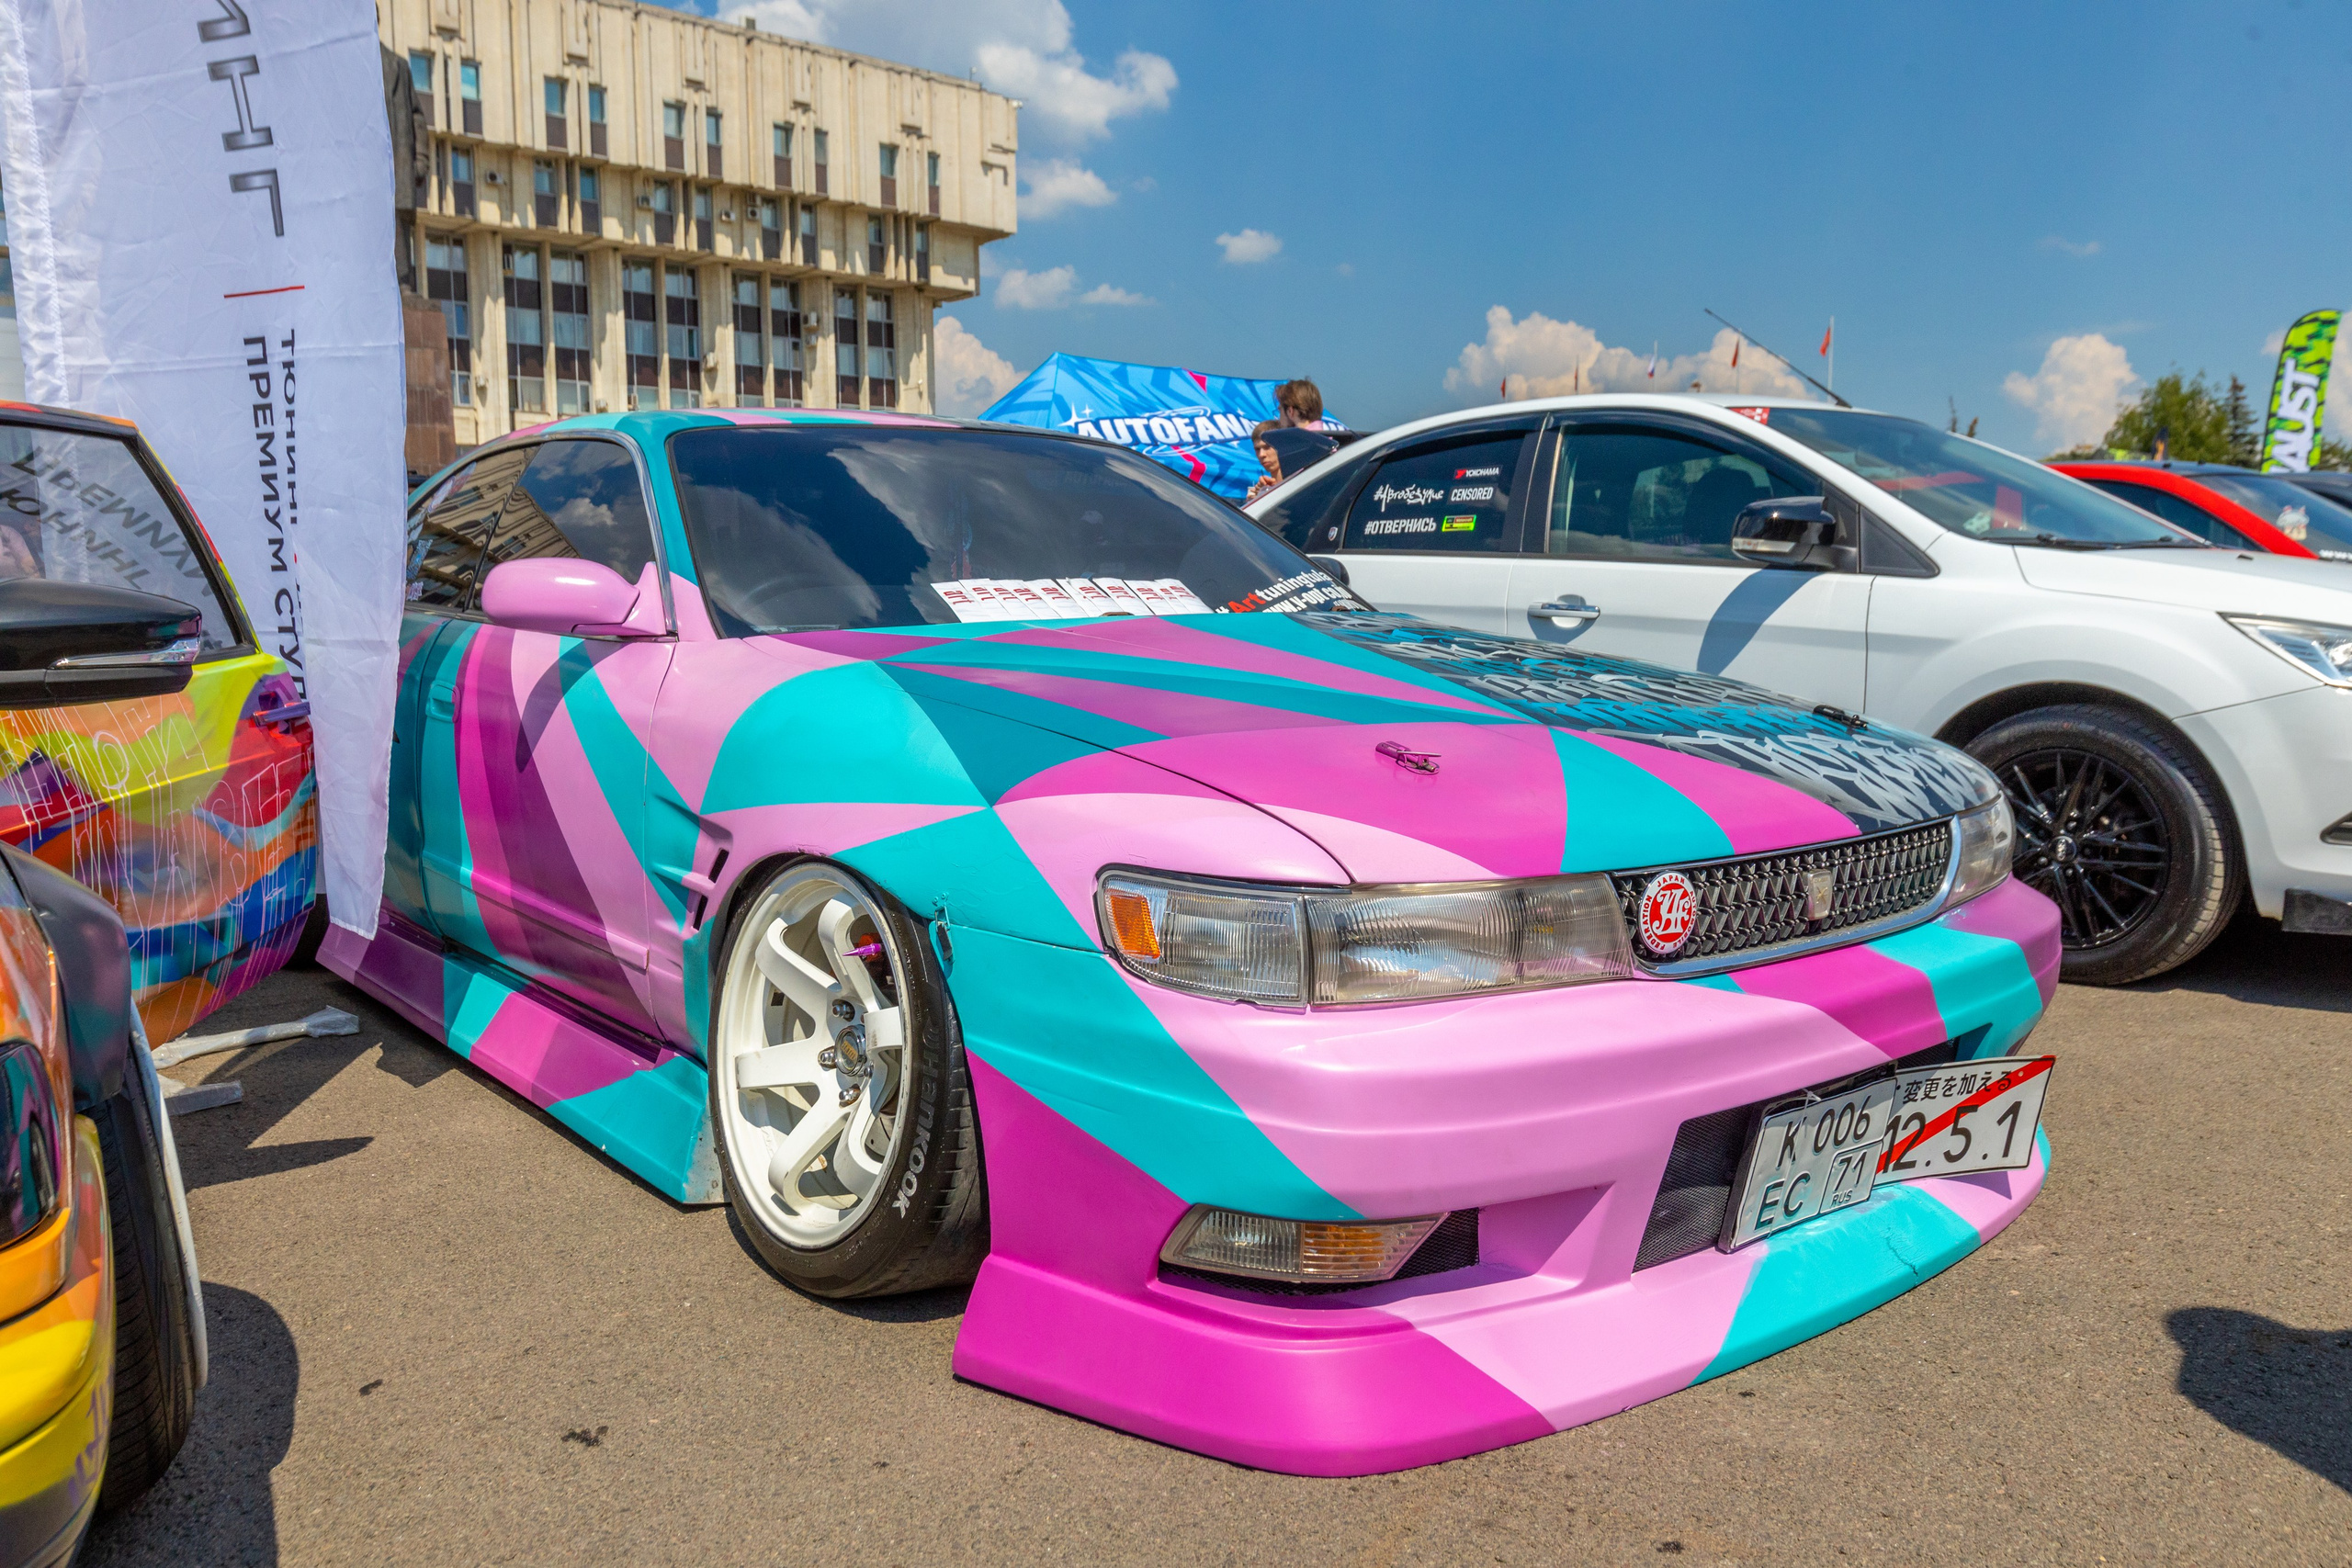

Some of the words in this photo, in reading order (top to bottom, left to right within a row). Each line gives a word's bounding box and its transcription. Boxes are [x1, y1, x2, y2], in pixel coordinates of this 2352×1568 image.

[243, 335, 288, 572] ПРЕМИУМ
[1465, 468, 1499, 478] YOKOHAMA
[1451, 487, 1494, 502] CENSORED
[1364, 518, 1437, 535] #ОТВЕРНИСЬ
[1657, 874, 1685, 887] JAPAN
[1642, 895, 1666, 950] FEDERATION
[1673, 890, 1696, 948] AUTOMOBILE
[1813, 1095, 1871, 1155] 006
[1834, 1151, 1868, 1192] 71
[1831, 1190, 1853, 1207] RUS
